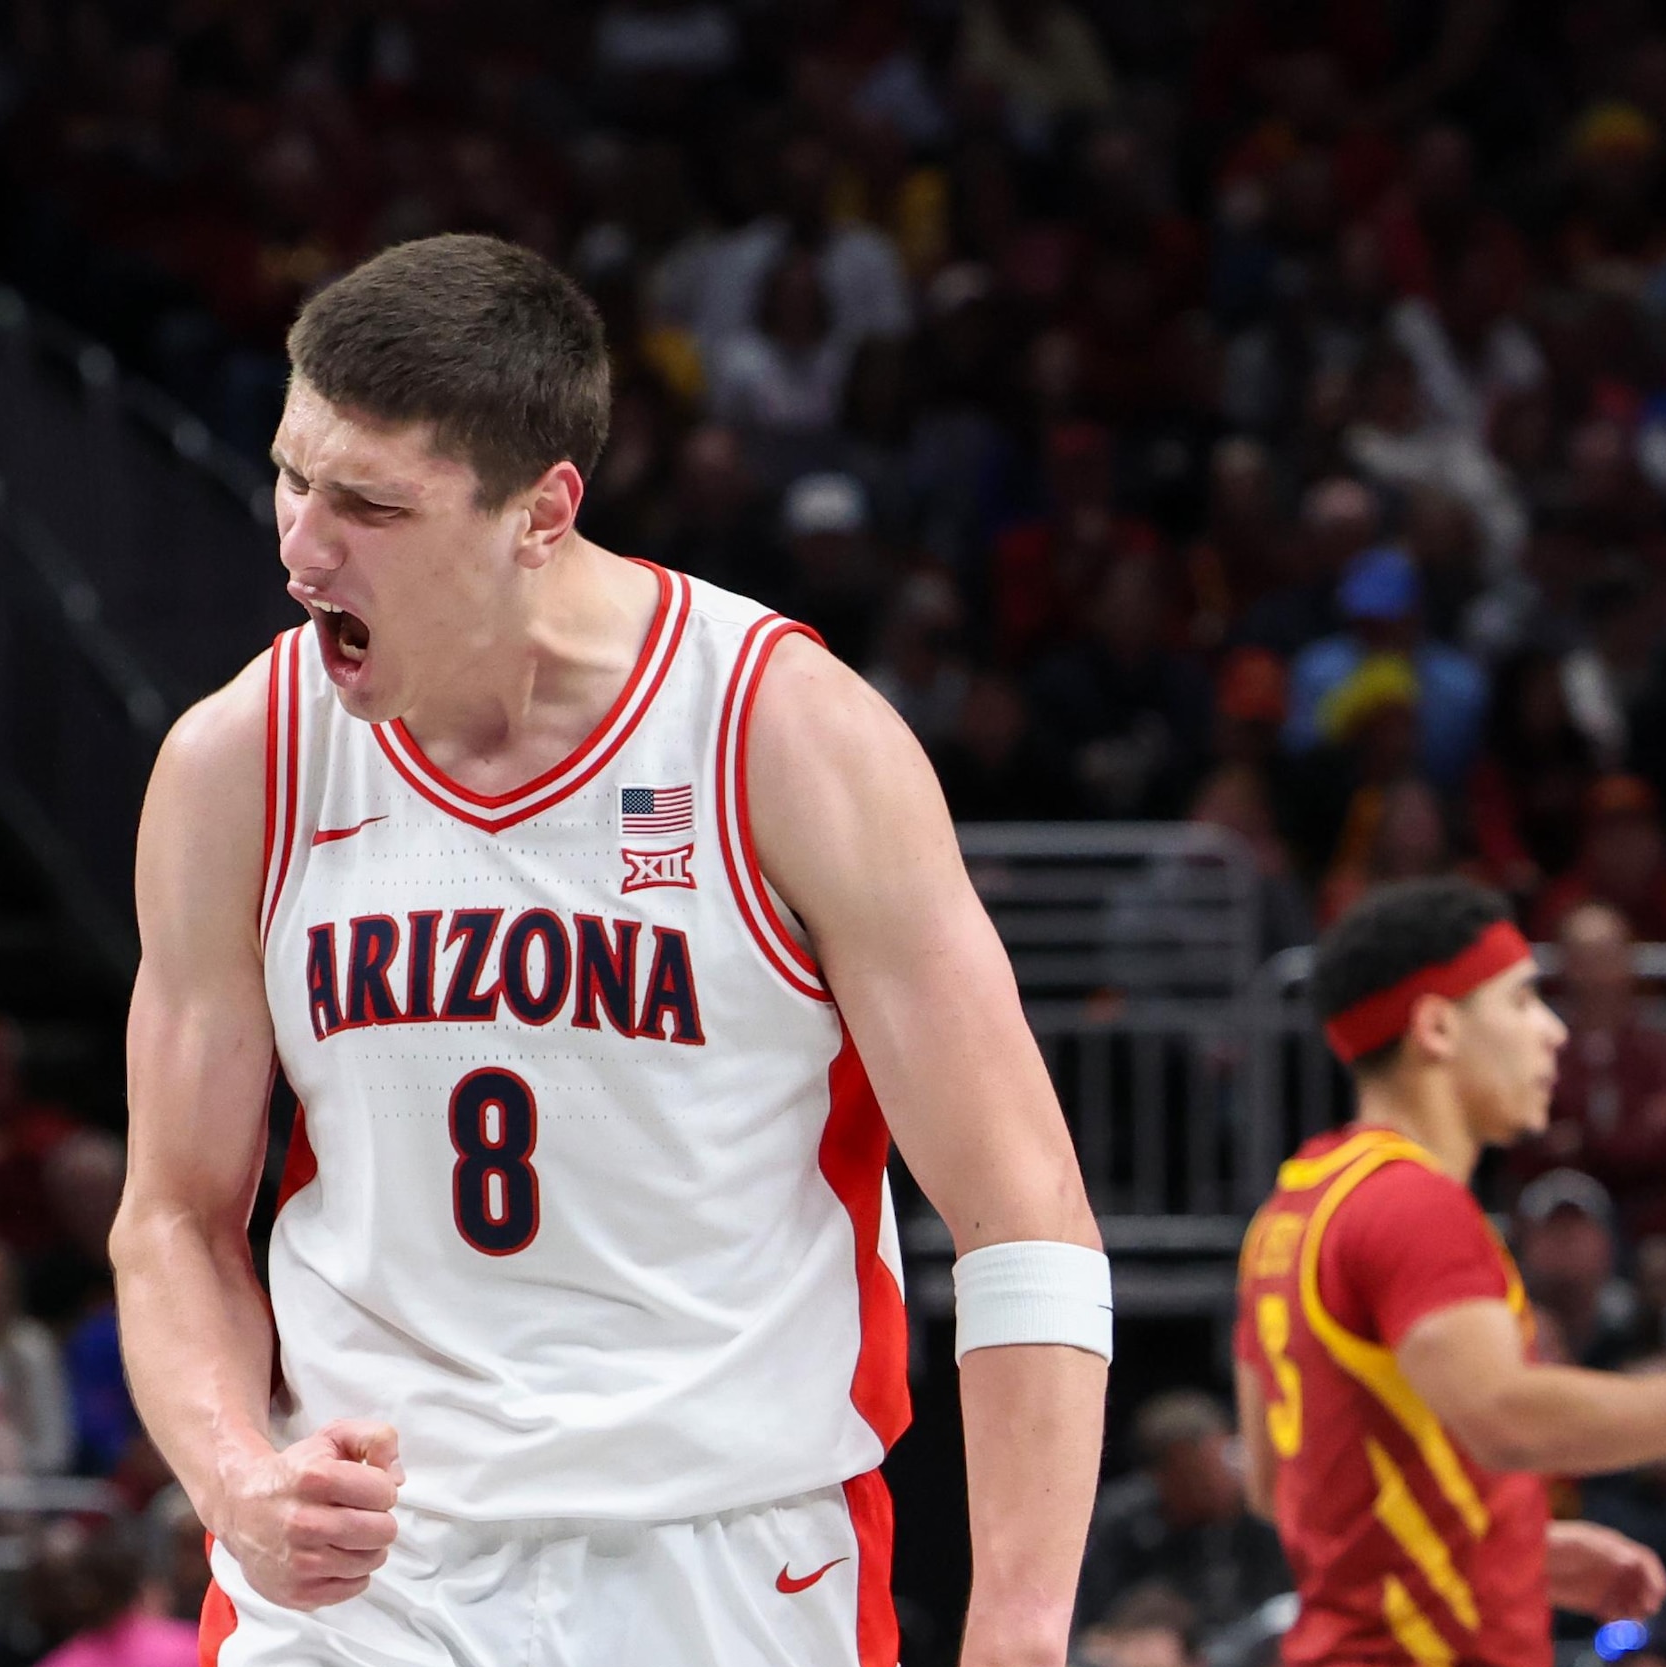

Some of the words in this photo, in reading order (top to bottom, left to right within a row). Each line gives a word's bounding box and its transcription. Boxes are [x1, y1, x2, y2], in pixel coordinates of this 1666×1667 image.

[624, 847, 693, 889] XII
[307, 907, 705, 1046] ARIZONA
[448, 1066, 541, 1257] 8
